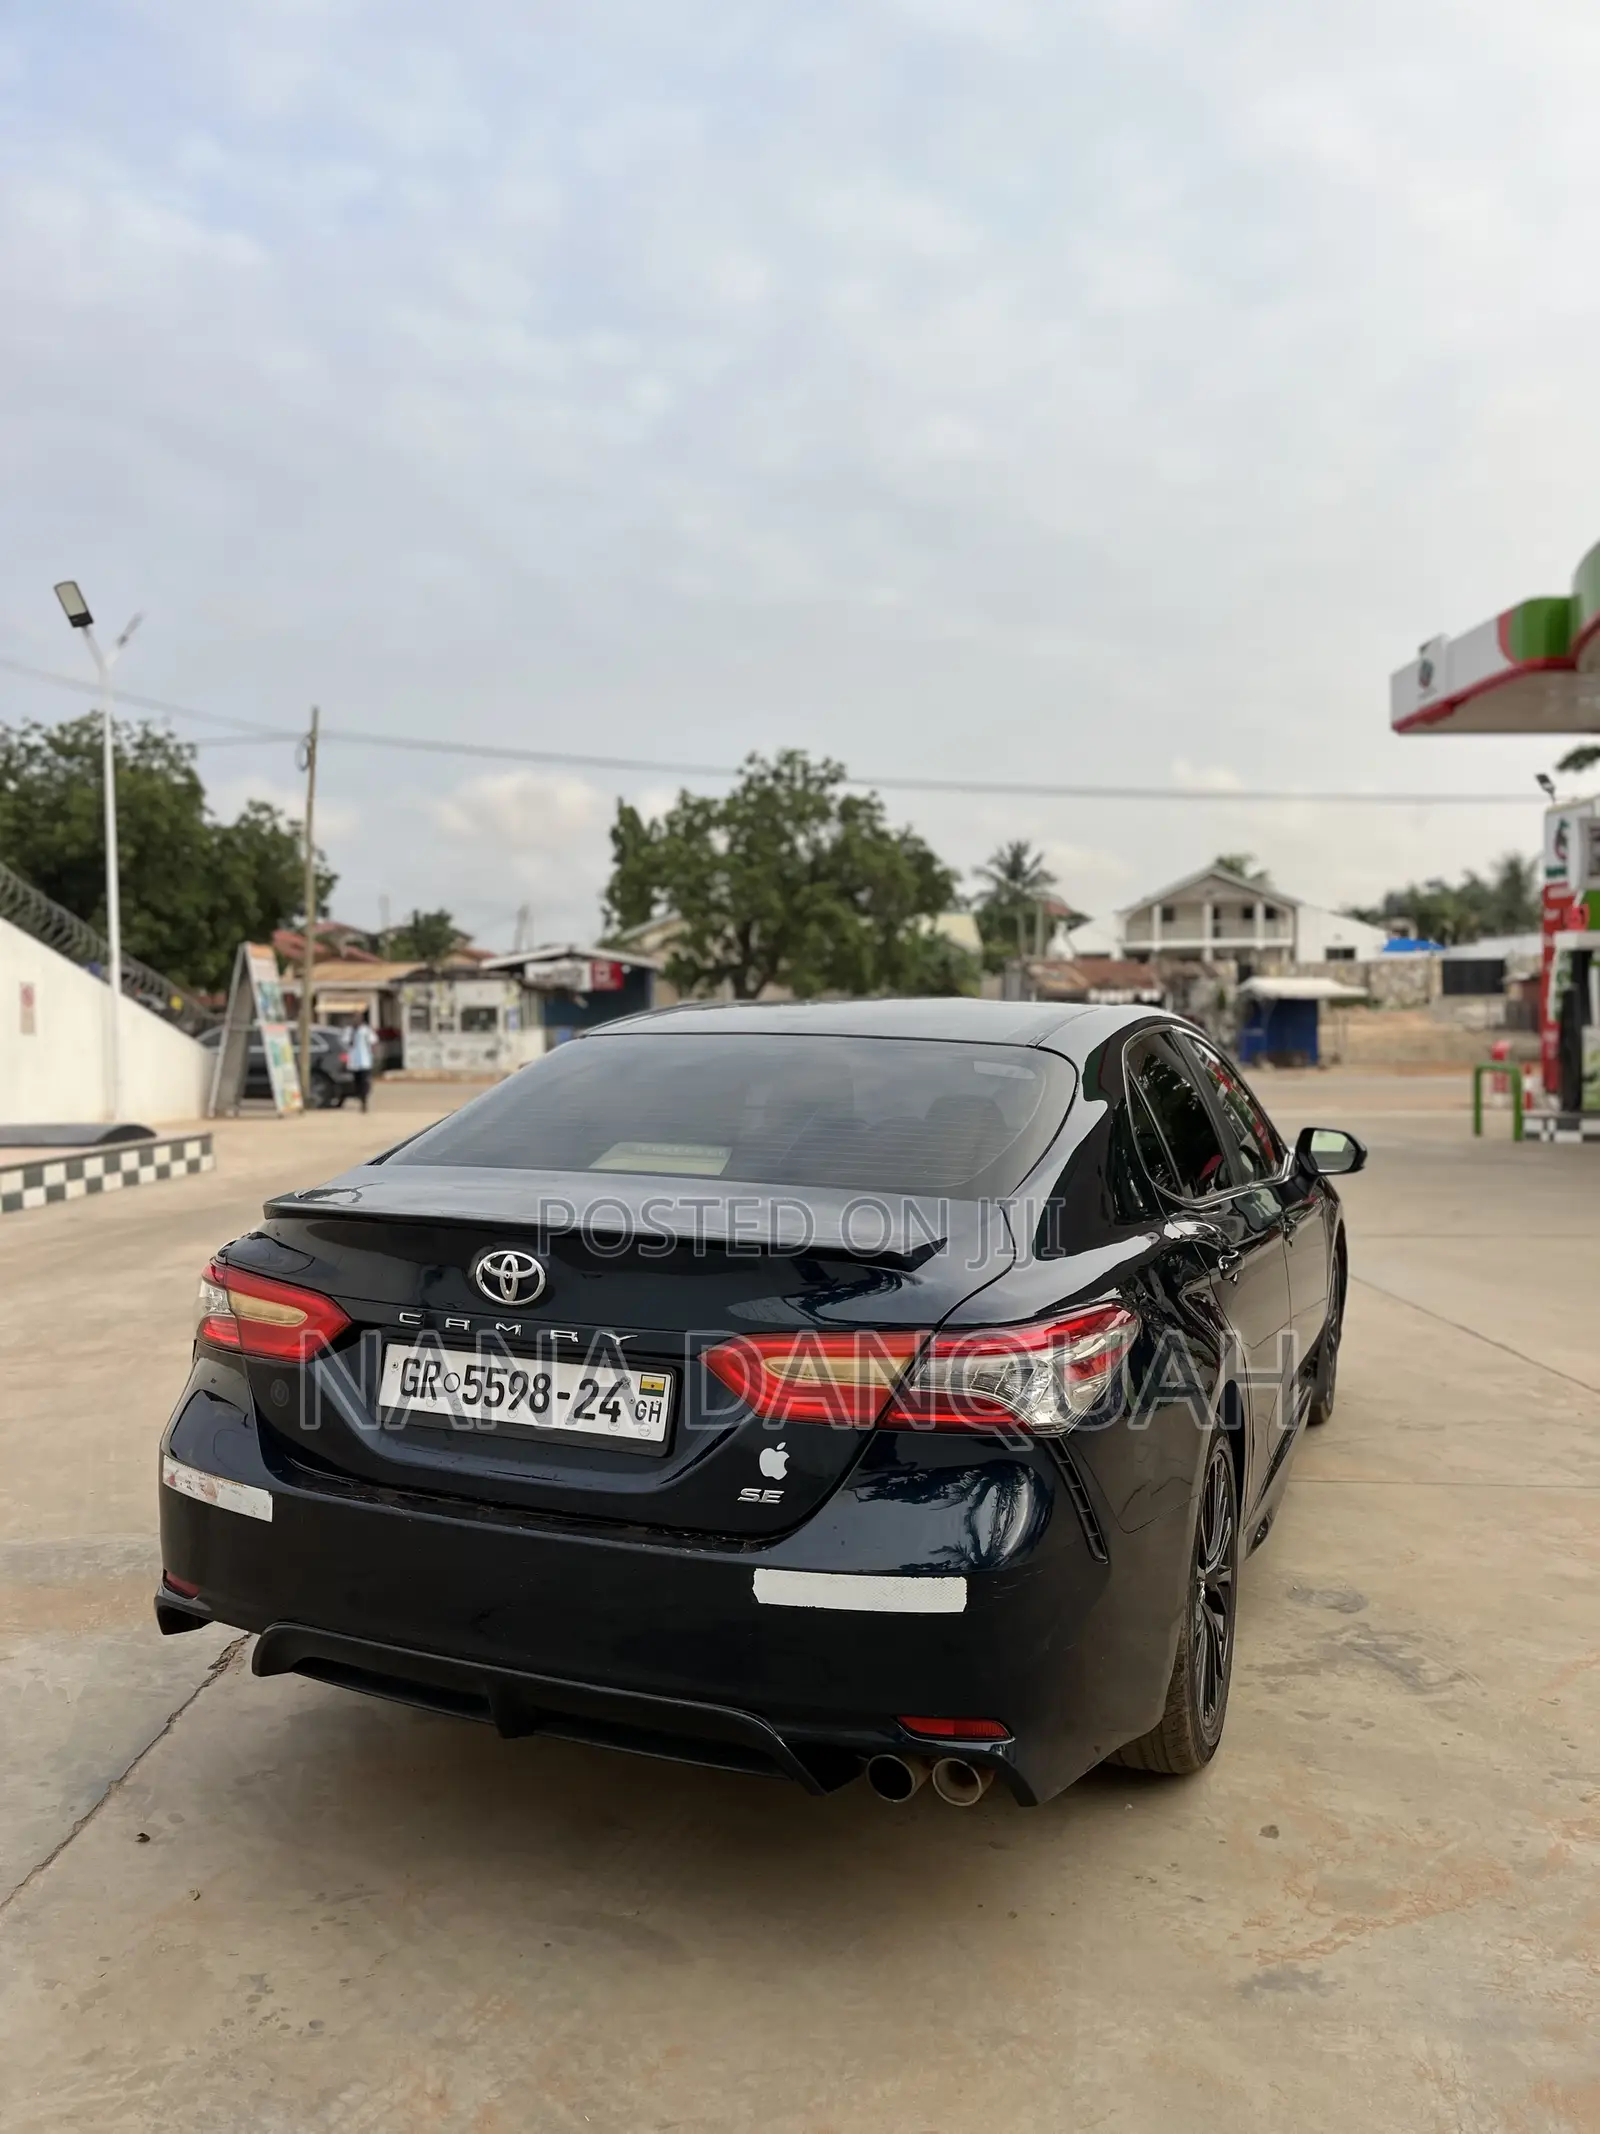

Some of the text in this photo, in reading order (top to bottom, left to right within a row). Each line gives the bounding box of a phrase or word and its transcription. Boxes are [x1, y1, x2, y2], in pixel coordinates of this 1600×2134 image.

[398, 1311, 639, 1346] CAMRY
[462, 1364, 625, 1423] 5598-24
[634, 1399, 662, 1424] GH
[736, 1487, 785, 1505] SE
